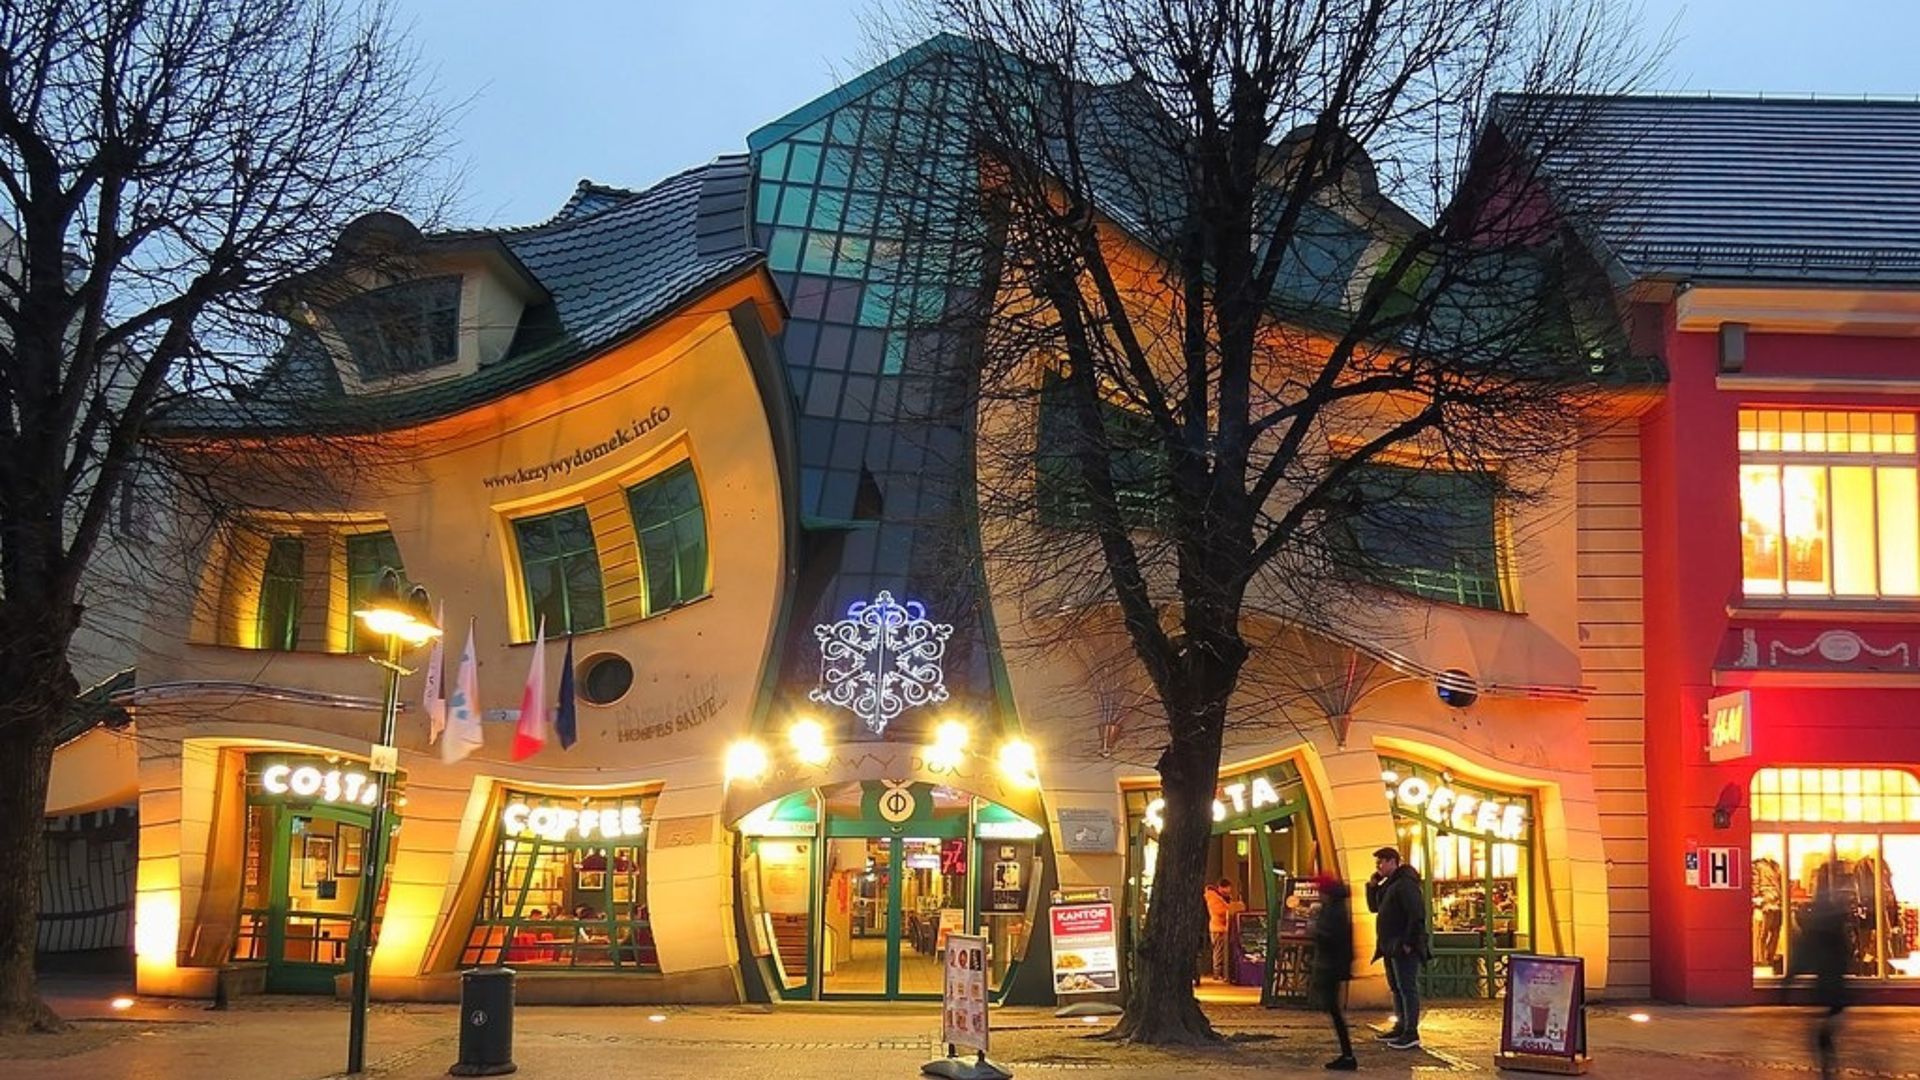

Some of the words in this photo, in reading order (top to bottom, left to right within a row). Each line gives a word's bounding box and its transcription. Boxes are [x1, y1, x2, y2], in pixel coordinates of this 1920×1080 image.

[483, 405, 671, 488] www.krzywydomek.info
[1712, 704, 1744, 747] H&M
[503, 803, 644, 841] COFFEE
[1711, 852, 1728, 884] H
[1056, 908, 1107, 921] KANTOR
